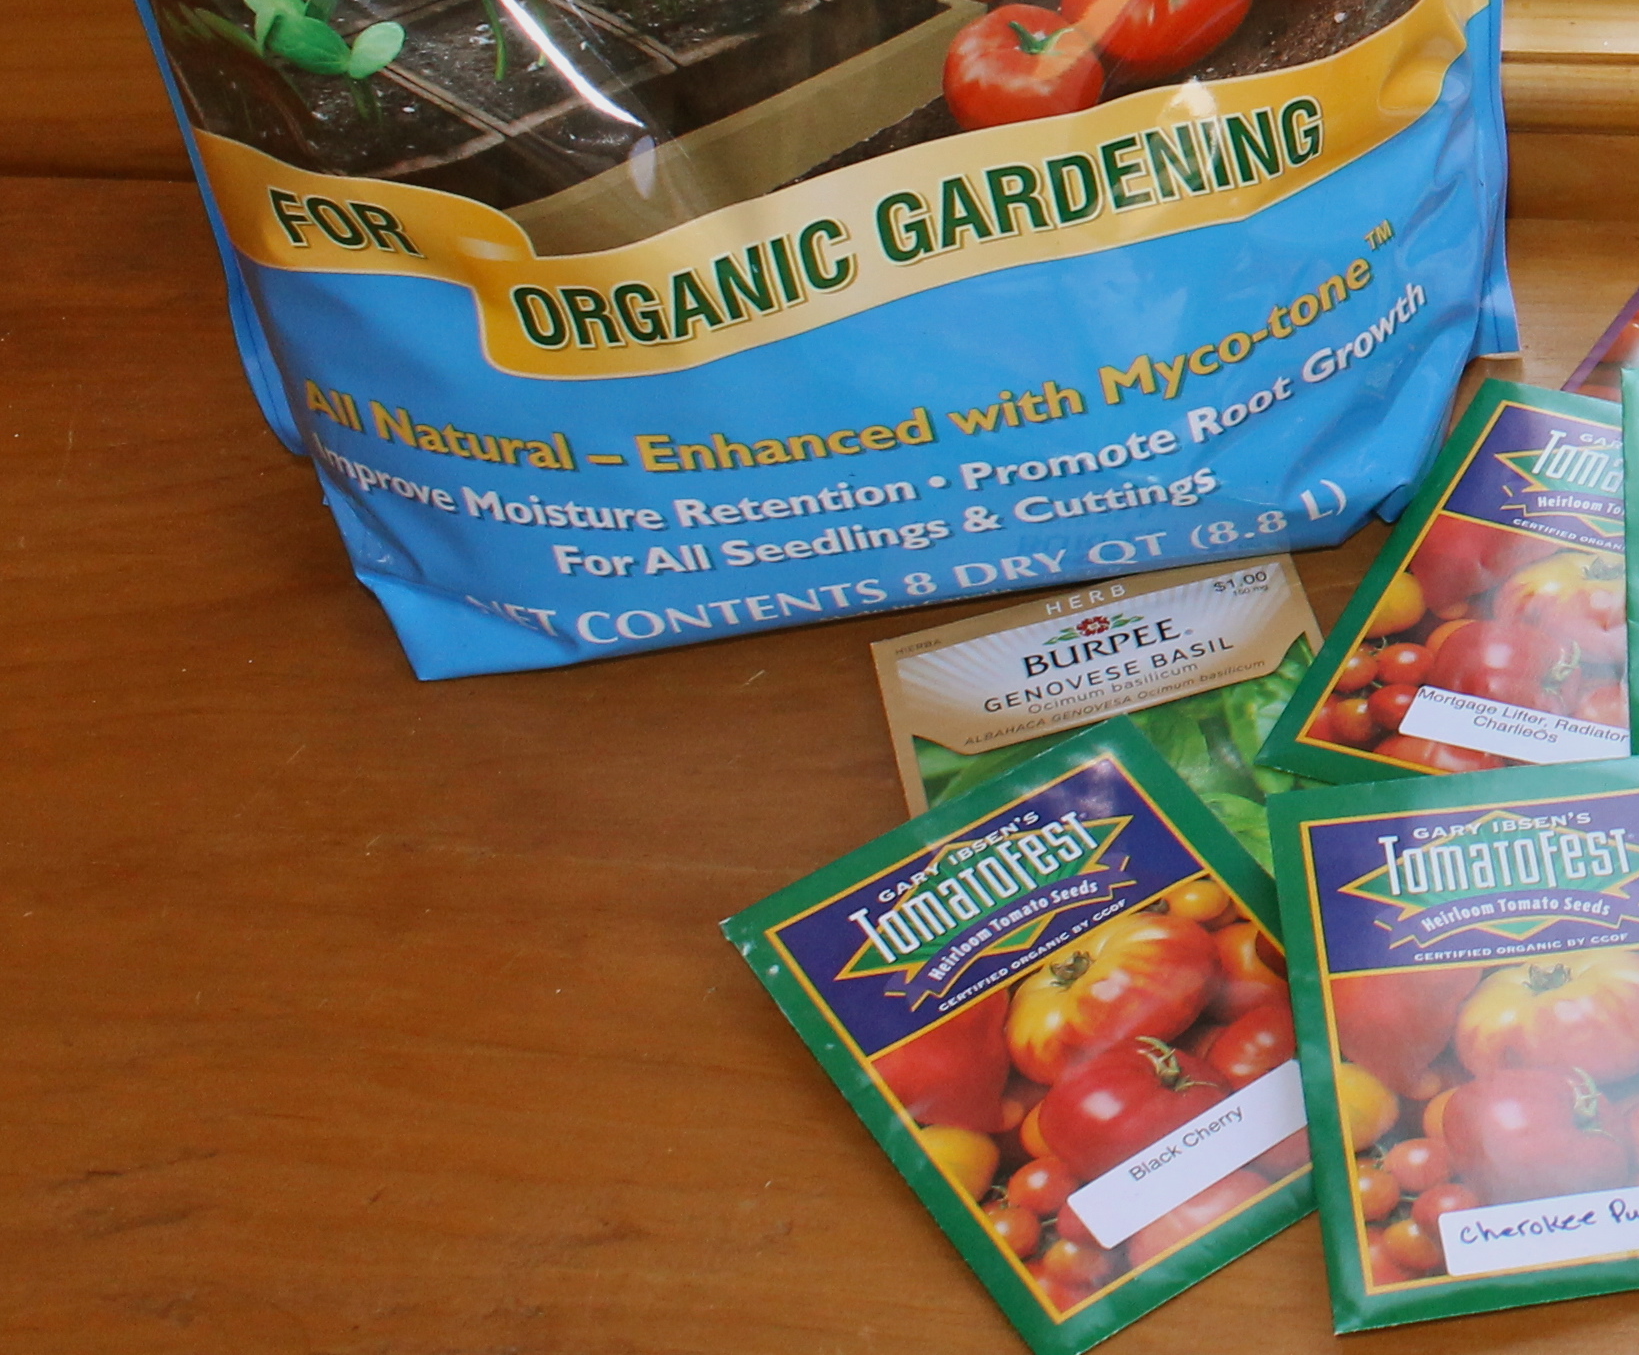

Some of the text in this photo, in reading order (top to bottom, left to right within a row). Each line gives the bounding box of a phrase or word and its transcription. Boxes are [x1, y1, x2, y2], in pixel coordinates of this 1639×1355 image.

[267, 188, 426, 259] FOR
[511, 94, 1324, 352] ORGANIC GARDENING
[305, 378, 364, 433] All
[371, 400, 576, 471] Natural
[635, 407, 934, 473] Enhanced
[948, 380, 1085, 436] with
[316, 280, 1427, 531] Improve Moisture Retention Promote Root Growth
[553, 467, 1219, 577] For All Seedlings & Cuttings
[1512, 518, 1577, 540] CERTIFIED
[1537, 495, 1602, 512] Heirloom
[465, 478, 1348, 646] NET CONTENTS 8 DRY QT (8.8 L)
[1212, 570, 1268, 594] $1.00
[1046, 584, 1127, 616] HERB
[983, 637, 1234, 714] GENOVESE BASIL
[1022, 618, 1184, 678] BURPEE
[1027, 662, 1199, 714] Ocimum basilicum
[1417, 688, 1499, 716] Mortgage
[1554, 718, 1629, 743] Radiator
[878, 810, 1041, 905] GARY IBSEN'S
[1413, 812, 1591, 840] GARY IBSEN'S
[927, 879, 1099, 984] Heirloom Tomato Seeds
[1414, 932, 1629, 962] CERTIFIED ORGANIC BY CCOF
[1421, 896, 1611, 933] Heirloom Tomato Seeds
[937, 899, 1127, 1013] CERTIFIED ORGANIC BY CCOF
[1128, 1105, 1245, 1184] Black Cherry
